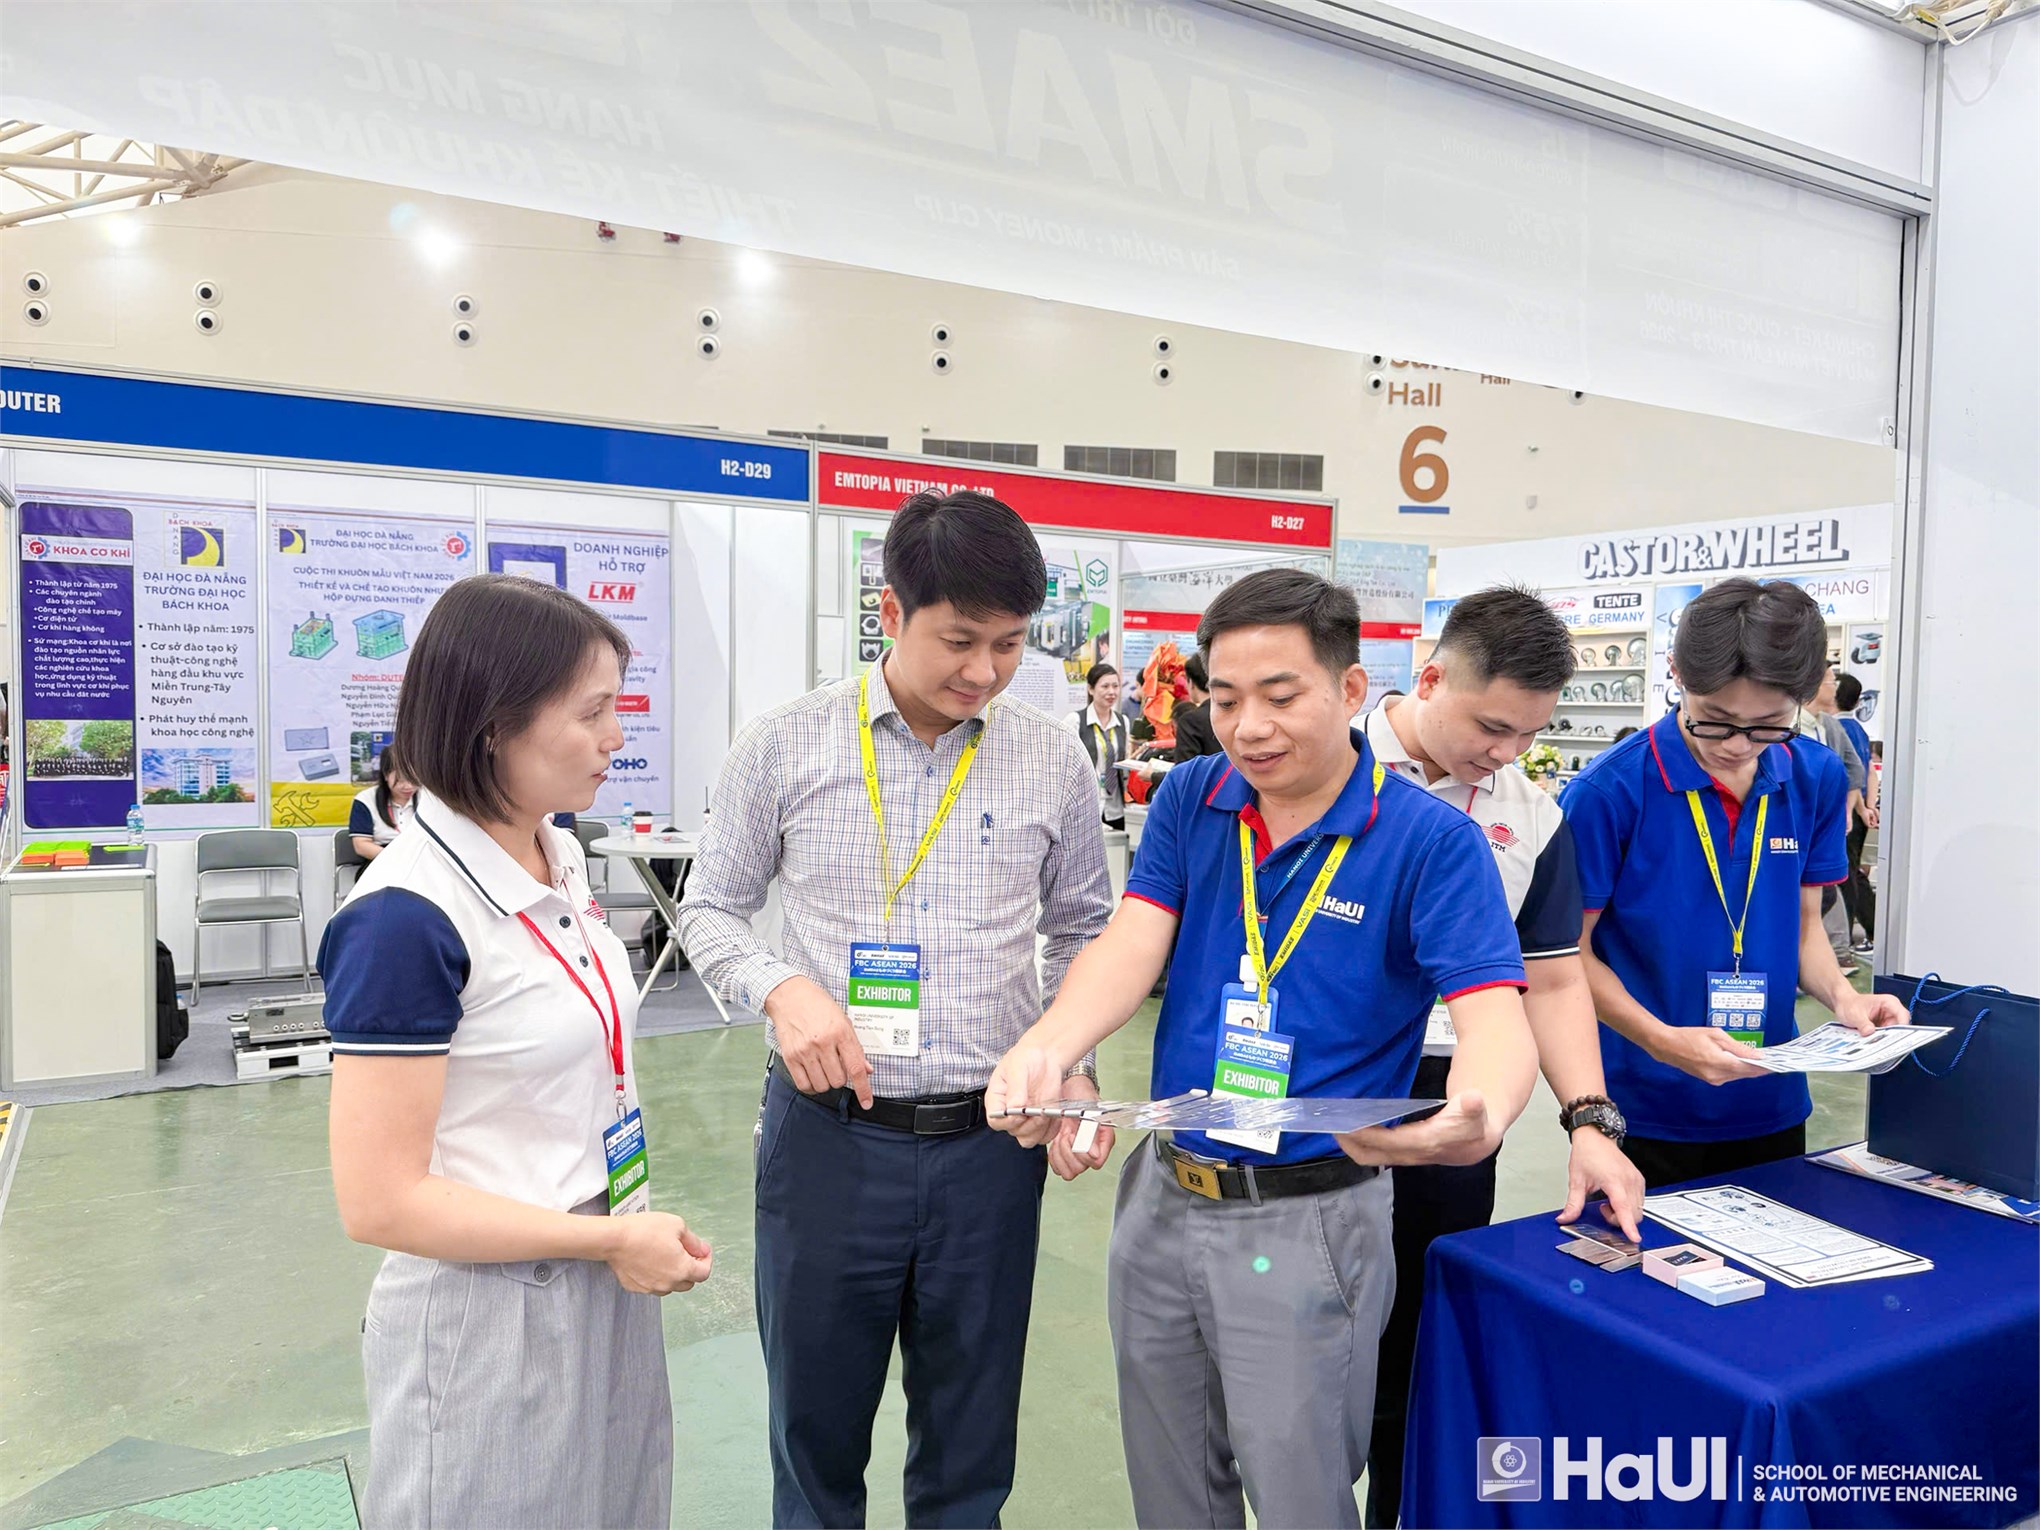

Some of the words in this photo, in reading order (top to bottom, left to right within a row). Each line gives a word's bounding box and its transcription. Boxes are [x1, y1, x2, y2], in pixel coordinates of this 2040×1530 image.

[1388, 382, 1441, 407] Hall
[720, 459, 772, 480] H2-D29
[1398, 425, 1450, 503] 6
[834, 471, 891, 492] EMTOPIA
[894, 478, 948, 496] VIETNAM
[1271, 515, 1305, 531] H2-D27
[54, 546, 87, 556] KHOA
[414, 545, 439, 553] KHOA
[574, 542, 620, 555] DOANH
[623, 544, 669, 559] NGHIỆP
[321, 567, 336, 575] THI
[413, 572, 433, 580] NAM
[434, 573, 455, 581] 2026
[620, 561, 646, 575] TRỢ
[143, 572, 163, 583] ĐẠI
[166, 573, 192, 584] HỌC
[195, 573, 212, 583] ĐÀ
[214, 572, 247, 585] NẴNG
[101, 582, 118, 590] 1975
[145, 585, 195, 596] TRƯỜNG
[198, 588, 218, 599] ĐẠI
[221, 589, 246, 600] HỌC
[588, 584, 636, 601] LKM
[162, 599, 194, 610] BÁCH
[197, 601, 230, 611] KHOA
[1596, 593, 1638, 608] TENTE
[1588, 611, 1646, 625] GERMANY
[147, 622, 181, 632] Thành
[183, 623, 200, 634] lập
[203, 624, 229, 633] năm:
[231, 625, 255, 634] 1975
[150, 642, 166, 651] Cơ
[168, 641, 182, 651] sở
[184, 643, 204, 652] đào
[206, 644, 224, 653] tạo
[212, 657, 238, 667] nghệ
[150, 668, 178, 679] hàng
[180, 667, 200, 678] đầu
[202, 670, 222, 678] khu
[224, 671, 245, 680] vực
[151, 679, 178, 691] Miền
[151, 695, 193, 706] Nguyên
[149, 714, 174, 723] Phát
[176, 714, 196, 725] huy
[198, 712, 216, 723] thế
[218, 715, 248, 725] mạnh
[151, 727, 177, 736] khoa
[180, 728, 199, 738] học
[202, 728, 227, 738] công
[229, 728, 255, 738] nghệ
[1323, 895, 1365, 920] HaUI
[854, 959, 869, 967] FBC
[870, 960, 898, 969] ASEAN
[898, 961, 917, 969] 2026
[857, 985, 912, 1002] EXHIBITOR
[1224, 1041, 1240, 1050] FBC
[1240, 1045, 1269, 1058] ASEAN
[1269, 1051, 1289, 1063] 2026
[1223, 1069, 1280, 1096] EXHIBITOR
[613, 1160, 645, 1197] EXHIBITOR
